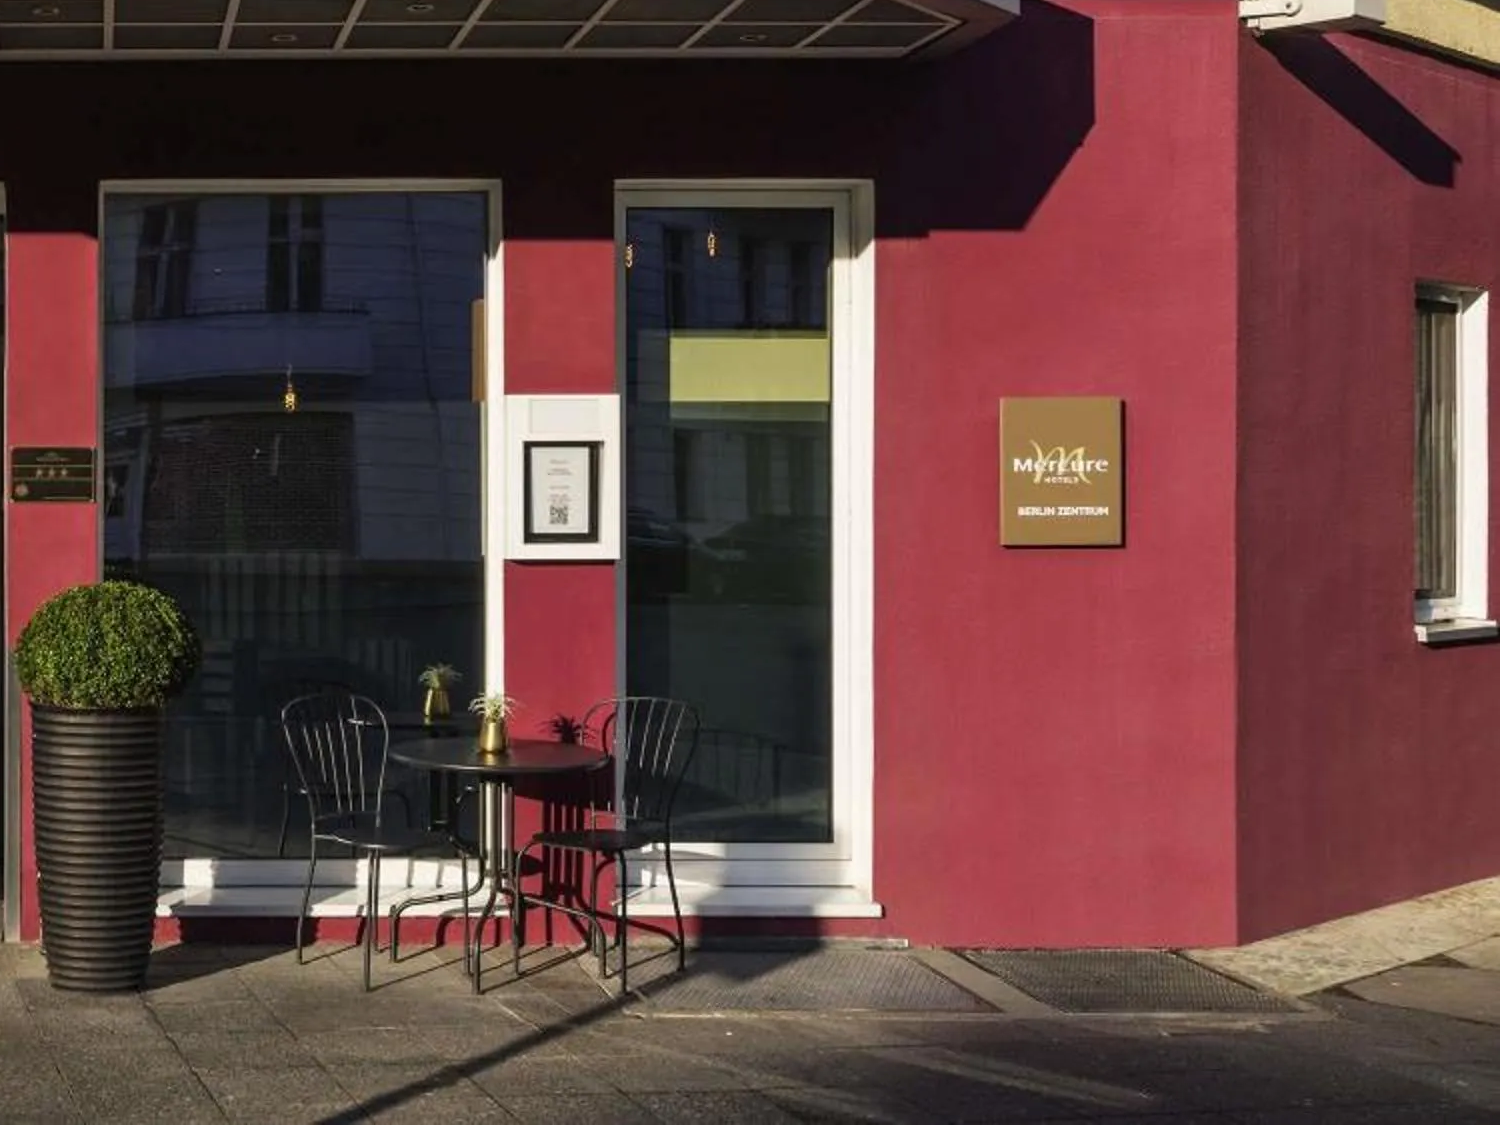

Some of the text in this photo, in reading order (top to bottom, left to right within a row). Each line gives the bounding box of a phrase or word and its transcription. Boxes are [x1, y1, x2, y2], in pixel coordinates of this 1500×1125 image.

[1013, 457, 1109, 473] Mercure
[1017, 506, 1109, 517] BERLIN ZENTRUM
